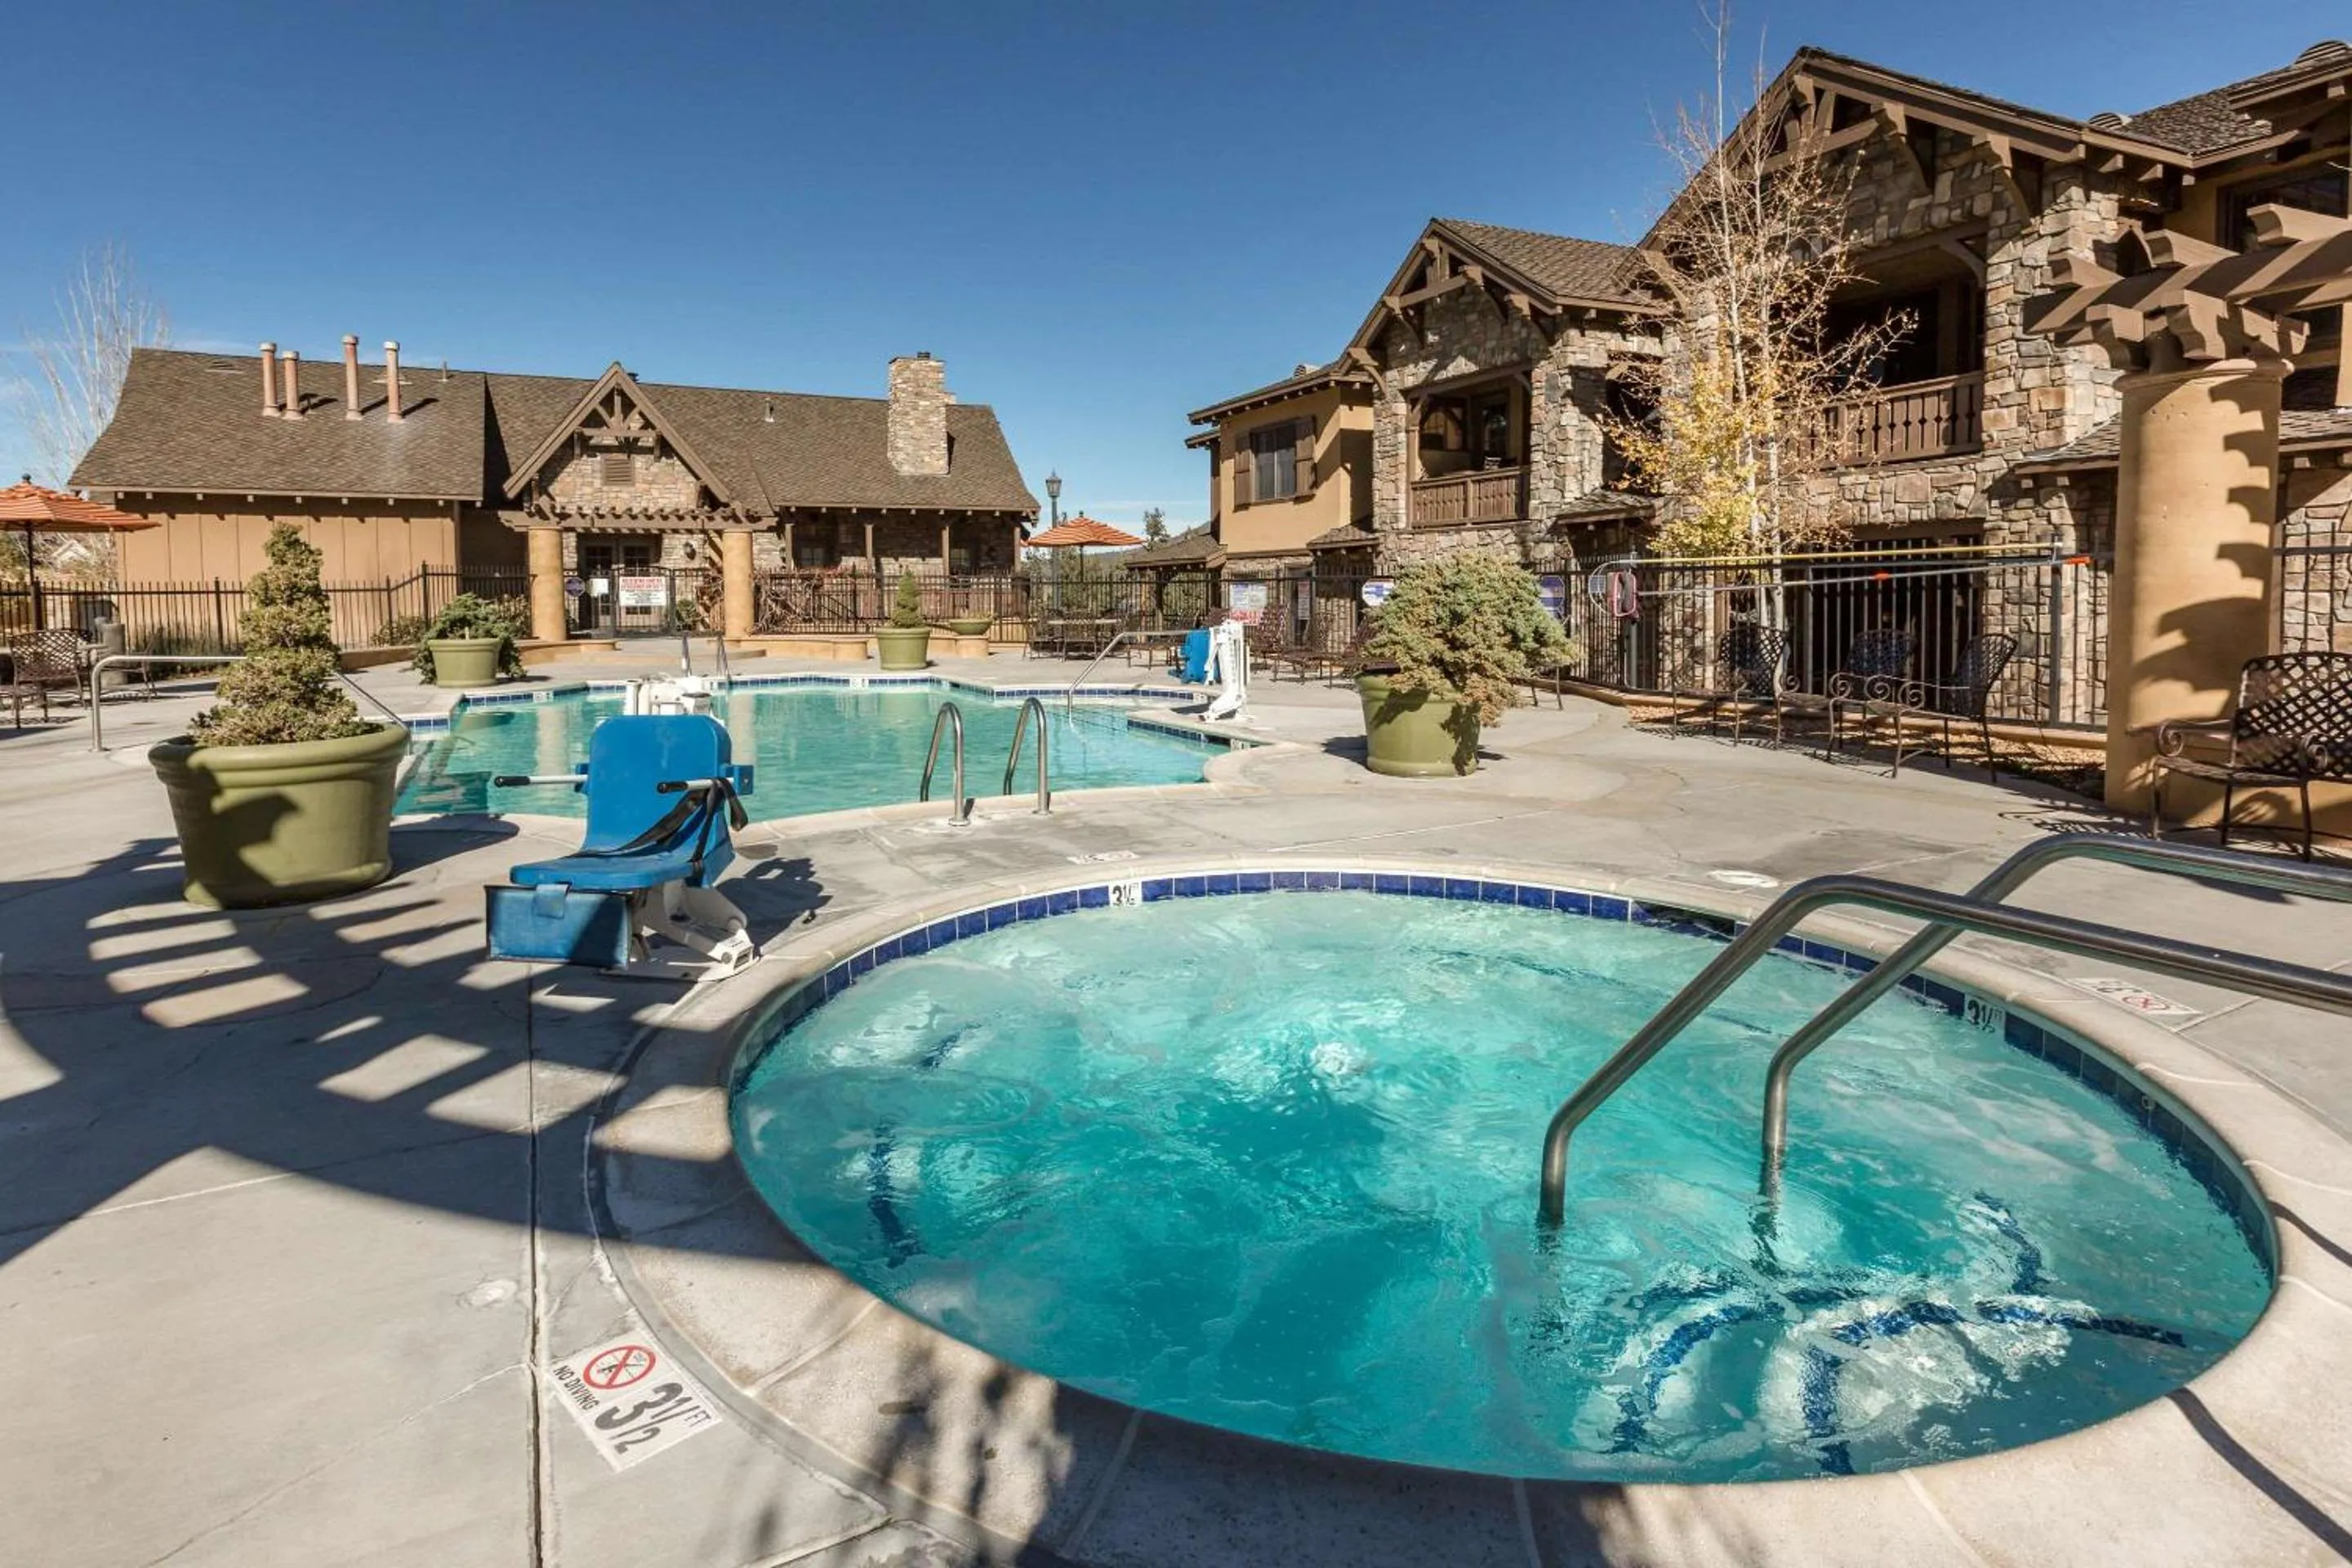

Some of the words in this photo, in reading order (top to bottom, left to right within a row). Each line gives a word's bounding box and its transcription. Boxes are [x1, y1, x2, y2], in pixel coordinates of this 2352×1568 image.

[553, 1365, 573, 1381] NO
[564, 1376, 599, 1410] DIVING
[684, 1410, 711, 1428] FT
